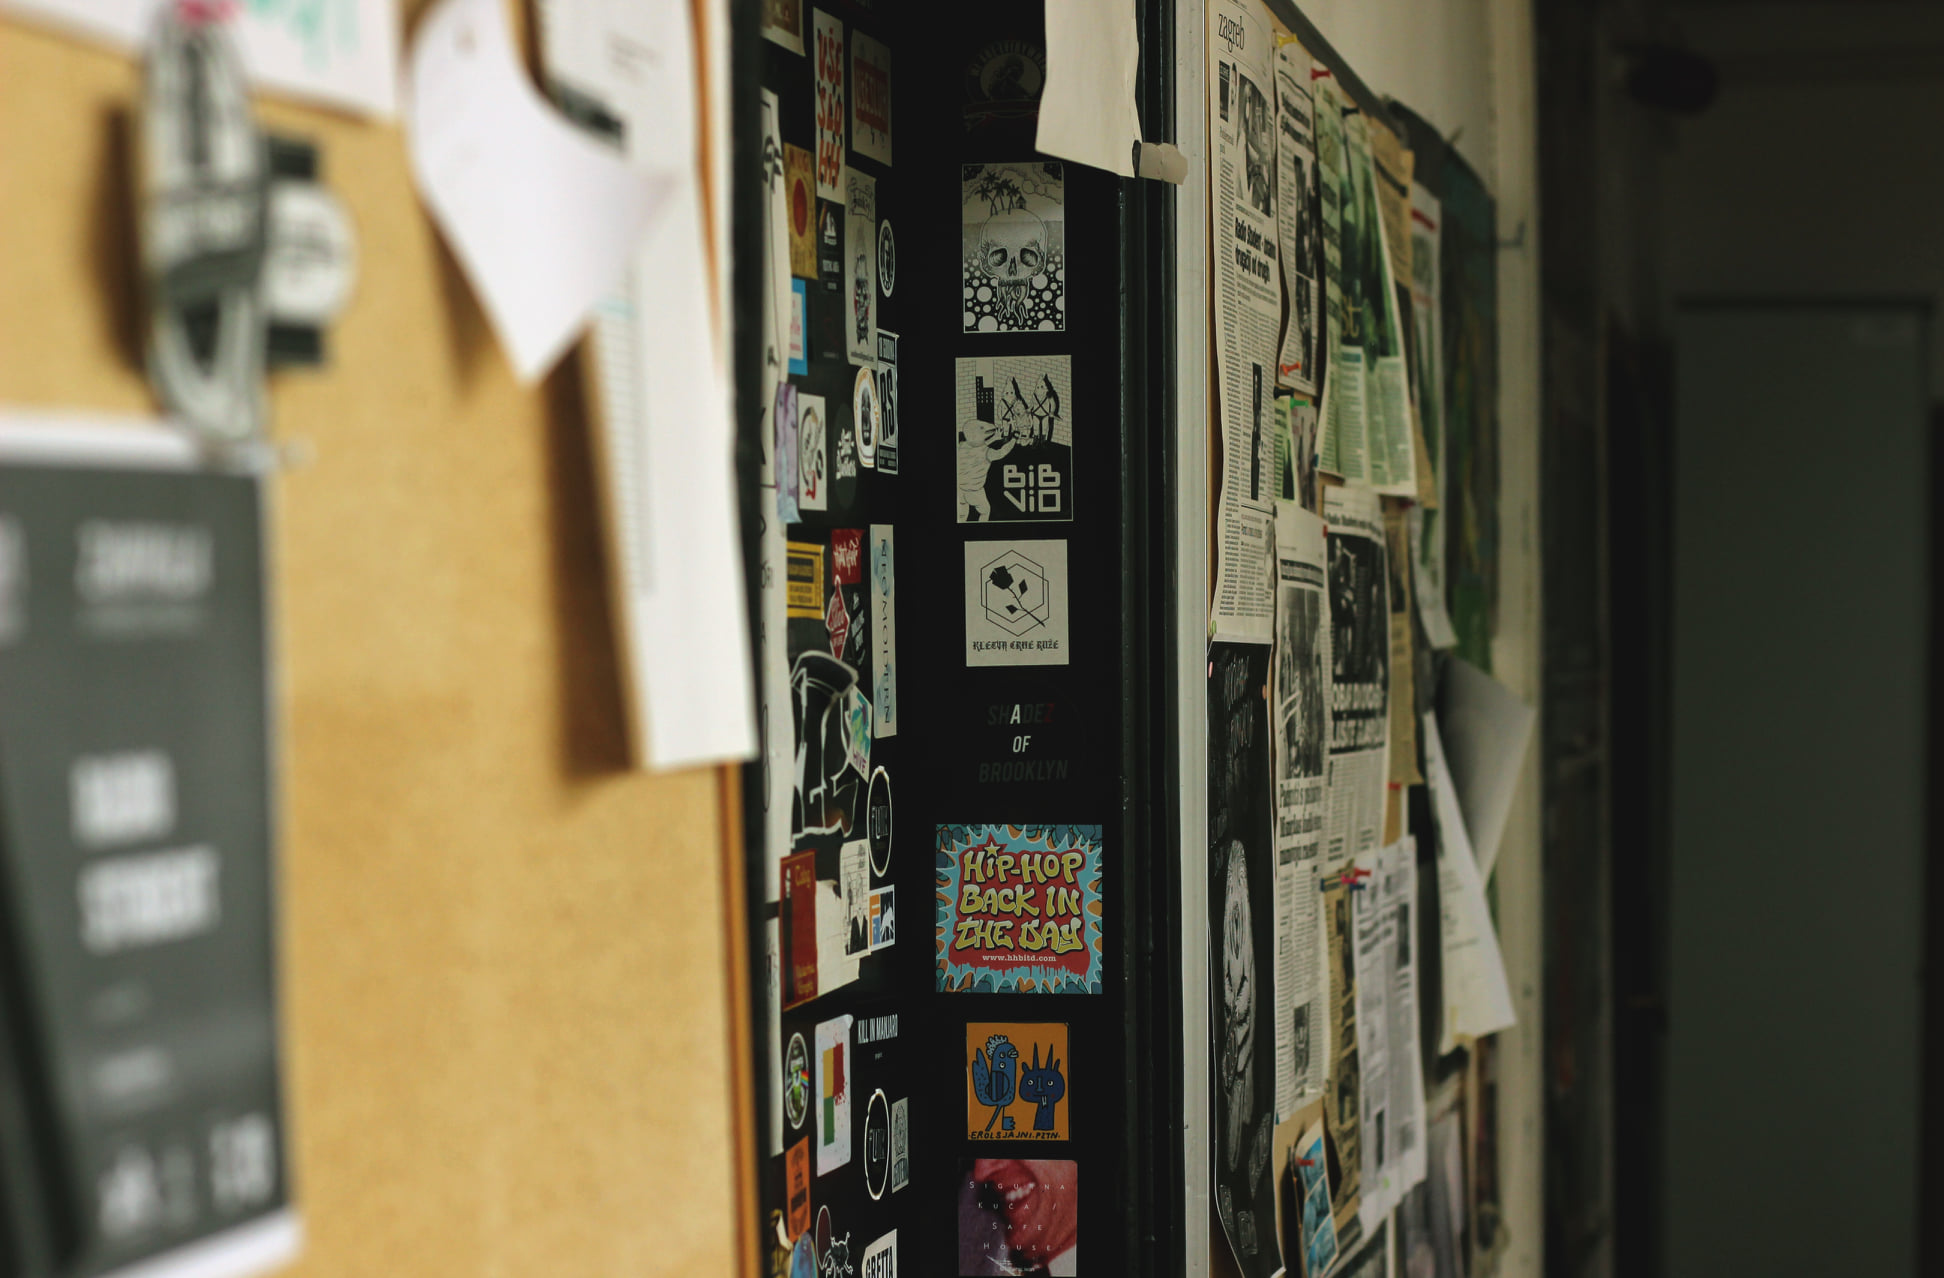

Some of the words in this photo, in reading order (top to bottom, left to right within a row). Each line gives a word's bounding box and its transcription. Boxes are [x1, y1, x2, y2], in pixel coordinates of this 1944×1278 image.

[1218, 13, 1245, 53] zagreb
[880, 369, 894, 441] RS
[973, 640, 1008, 653] KLETVA
[1010, 640, 1034, 652] CRNE
[987, 703, 1056, 726] SHADEZ
[1012, 735, 1031, 753] OF
[978, 759, 1068, 784] BROOKLYN
[959, 883, 1041, 917] BACK
[1045, 885, 1083, 919] IN
[954, 917, 1015, 951] THE
[1018, 917, 1085, 954] DAY
[982, 954, 1057, 962] www.hhbitd.com
[969, 1180, 1066, 1191] SIGURNA
[991, 1221, 1045, 1232] SAFE
[982, 1241, 1053, 1252] HOUSE
